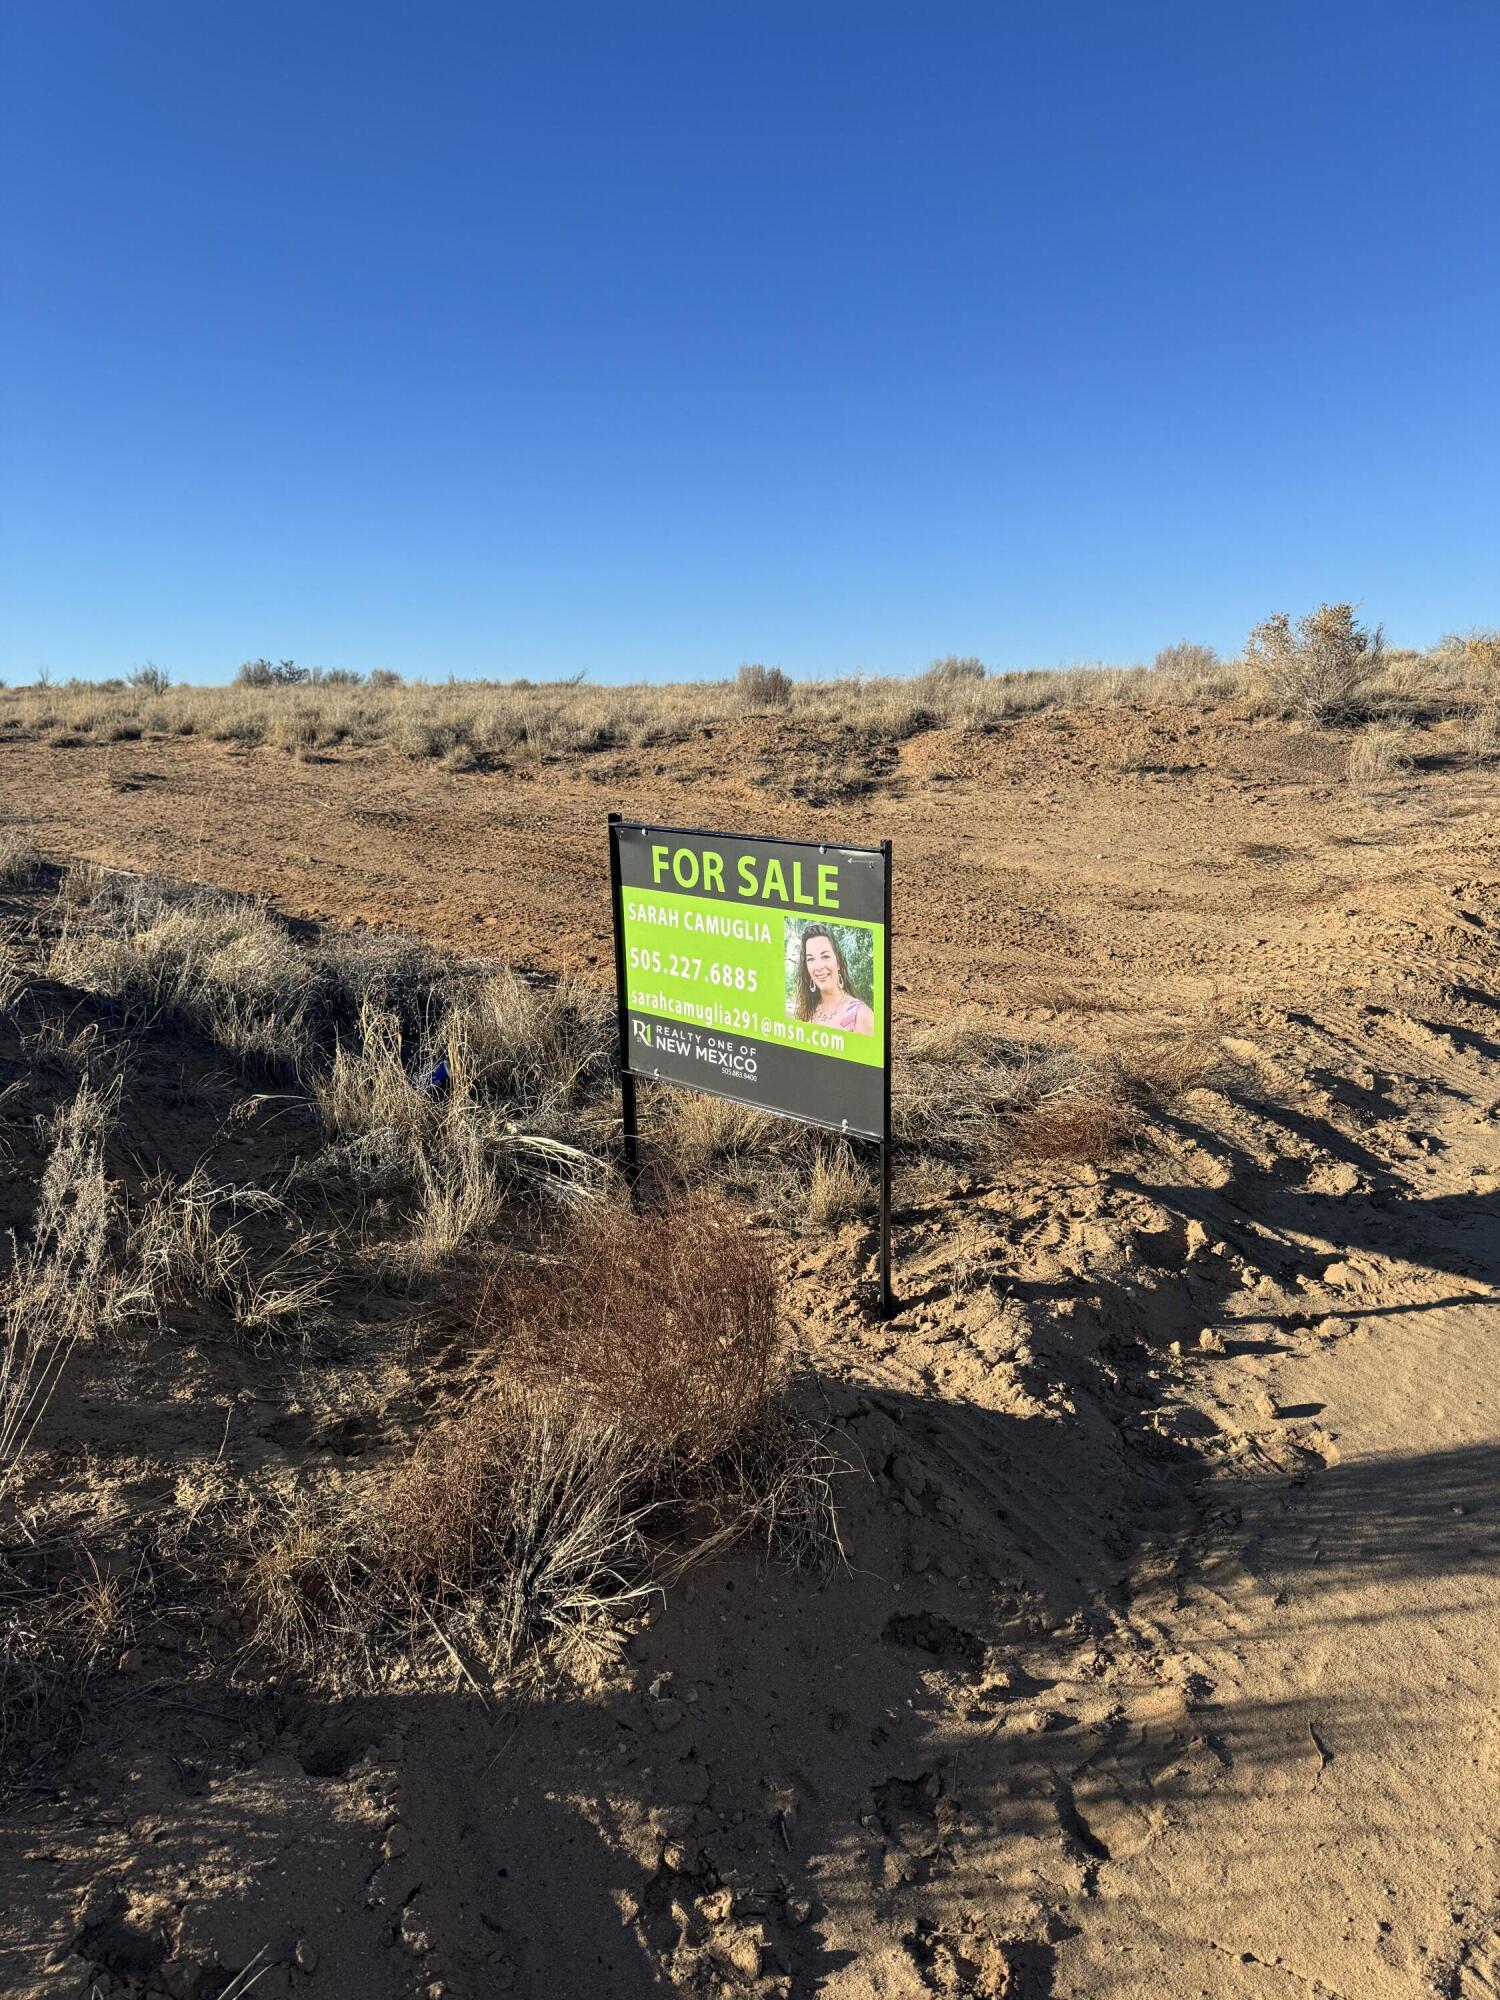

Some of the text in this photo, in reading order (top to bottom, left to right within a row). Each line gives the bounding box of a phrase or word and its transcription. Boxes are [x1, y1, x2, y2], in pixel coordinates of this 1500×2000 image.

[652, 845, 840, 909] FOR SALE
[628, 902, 772, 944] SARAH CAMUGLIA
[630, 947, 758, 992] 505.227.6885
[631, 989, 845, 1052] sarahcamuglia291@msn.com
[656, 1025, 757, 1057] REALTY ONE OF
[656, 1036, 757, 1073] NEW MEXICO
